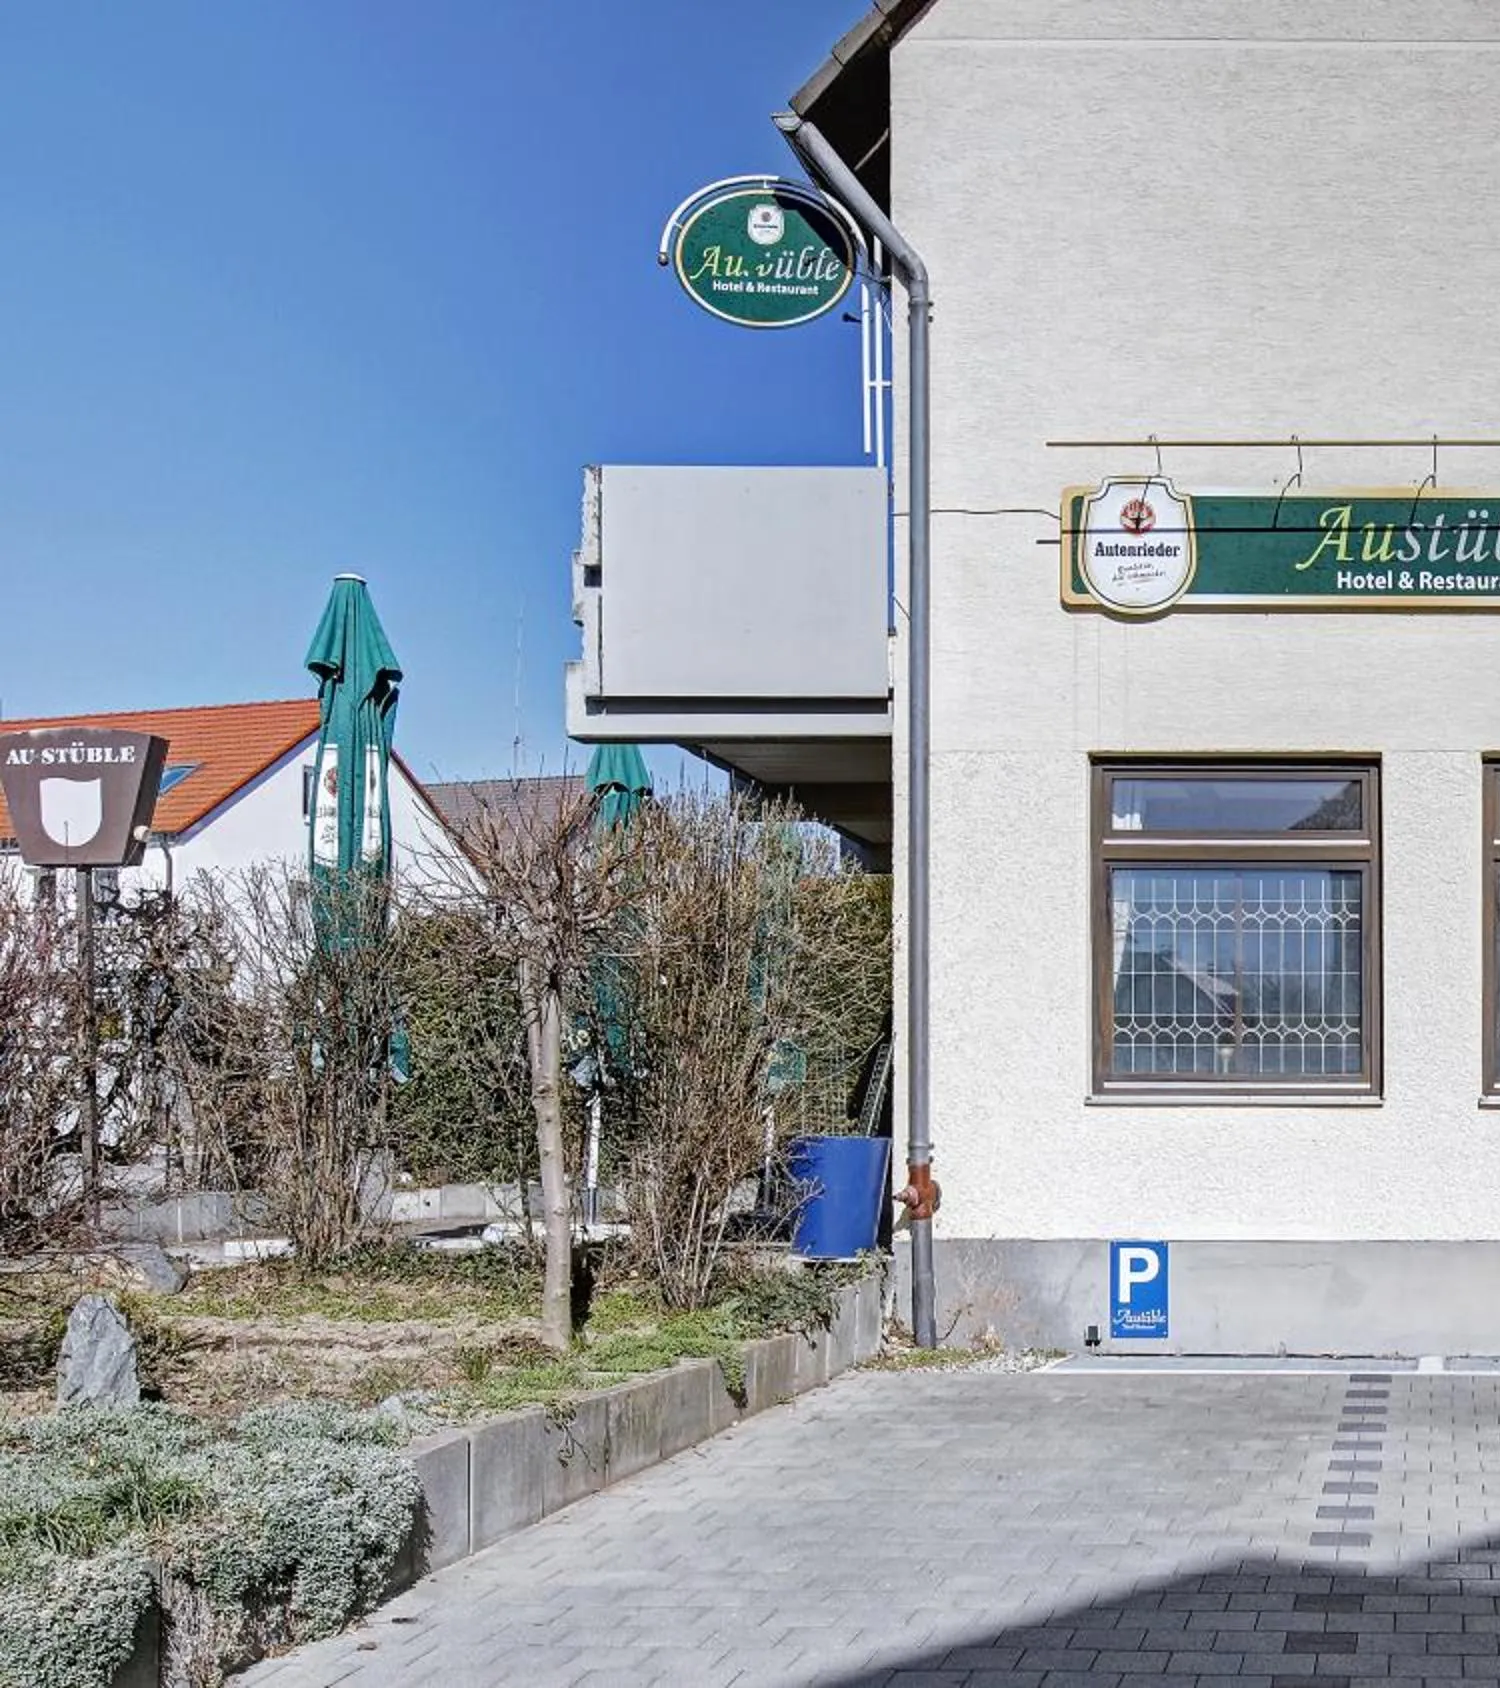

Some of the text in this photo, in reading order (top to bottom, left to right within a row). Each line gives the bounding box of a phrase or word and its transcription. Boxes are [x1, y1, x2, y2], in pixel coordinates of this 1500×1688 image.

[713, 280, 819, 295] Hotel & Restaurant
[1094, 541, 1181, 557] Autenrieder
[1336, 570, 1393, 590] Hotel
[1398, 571, 1414, 590] &
[1119, 1247, 1160, 1304] P
